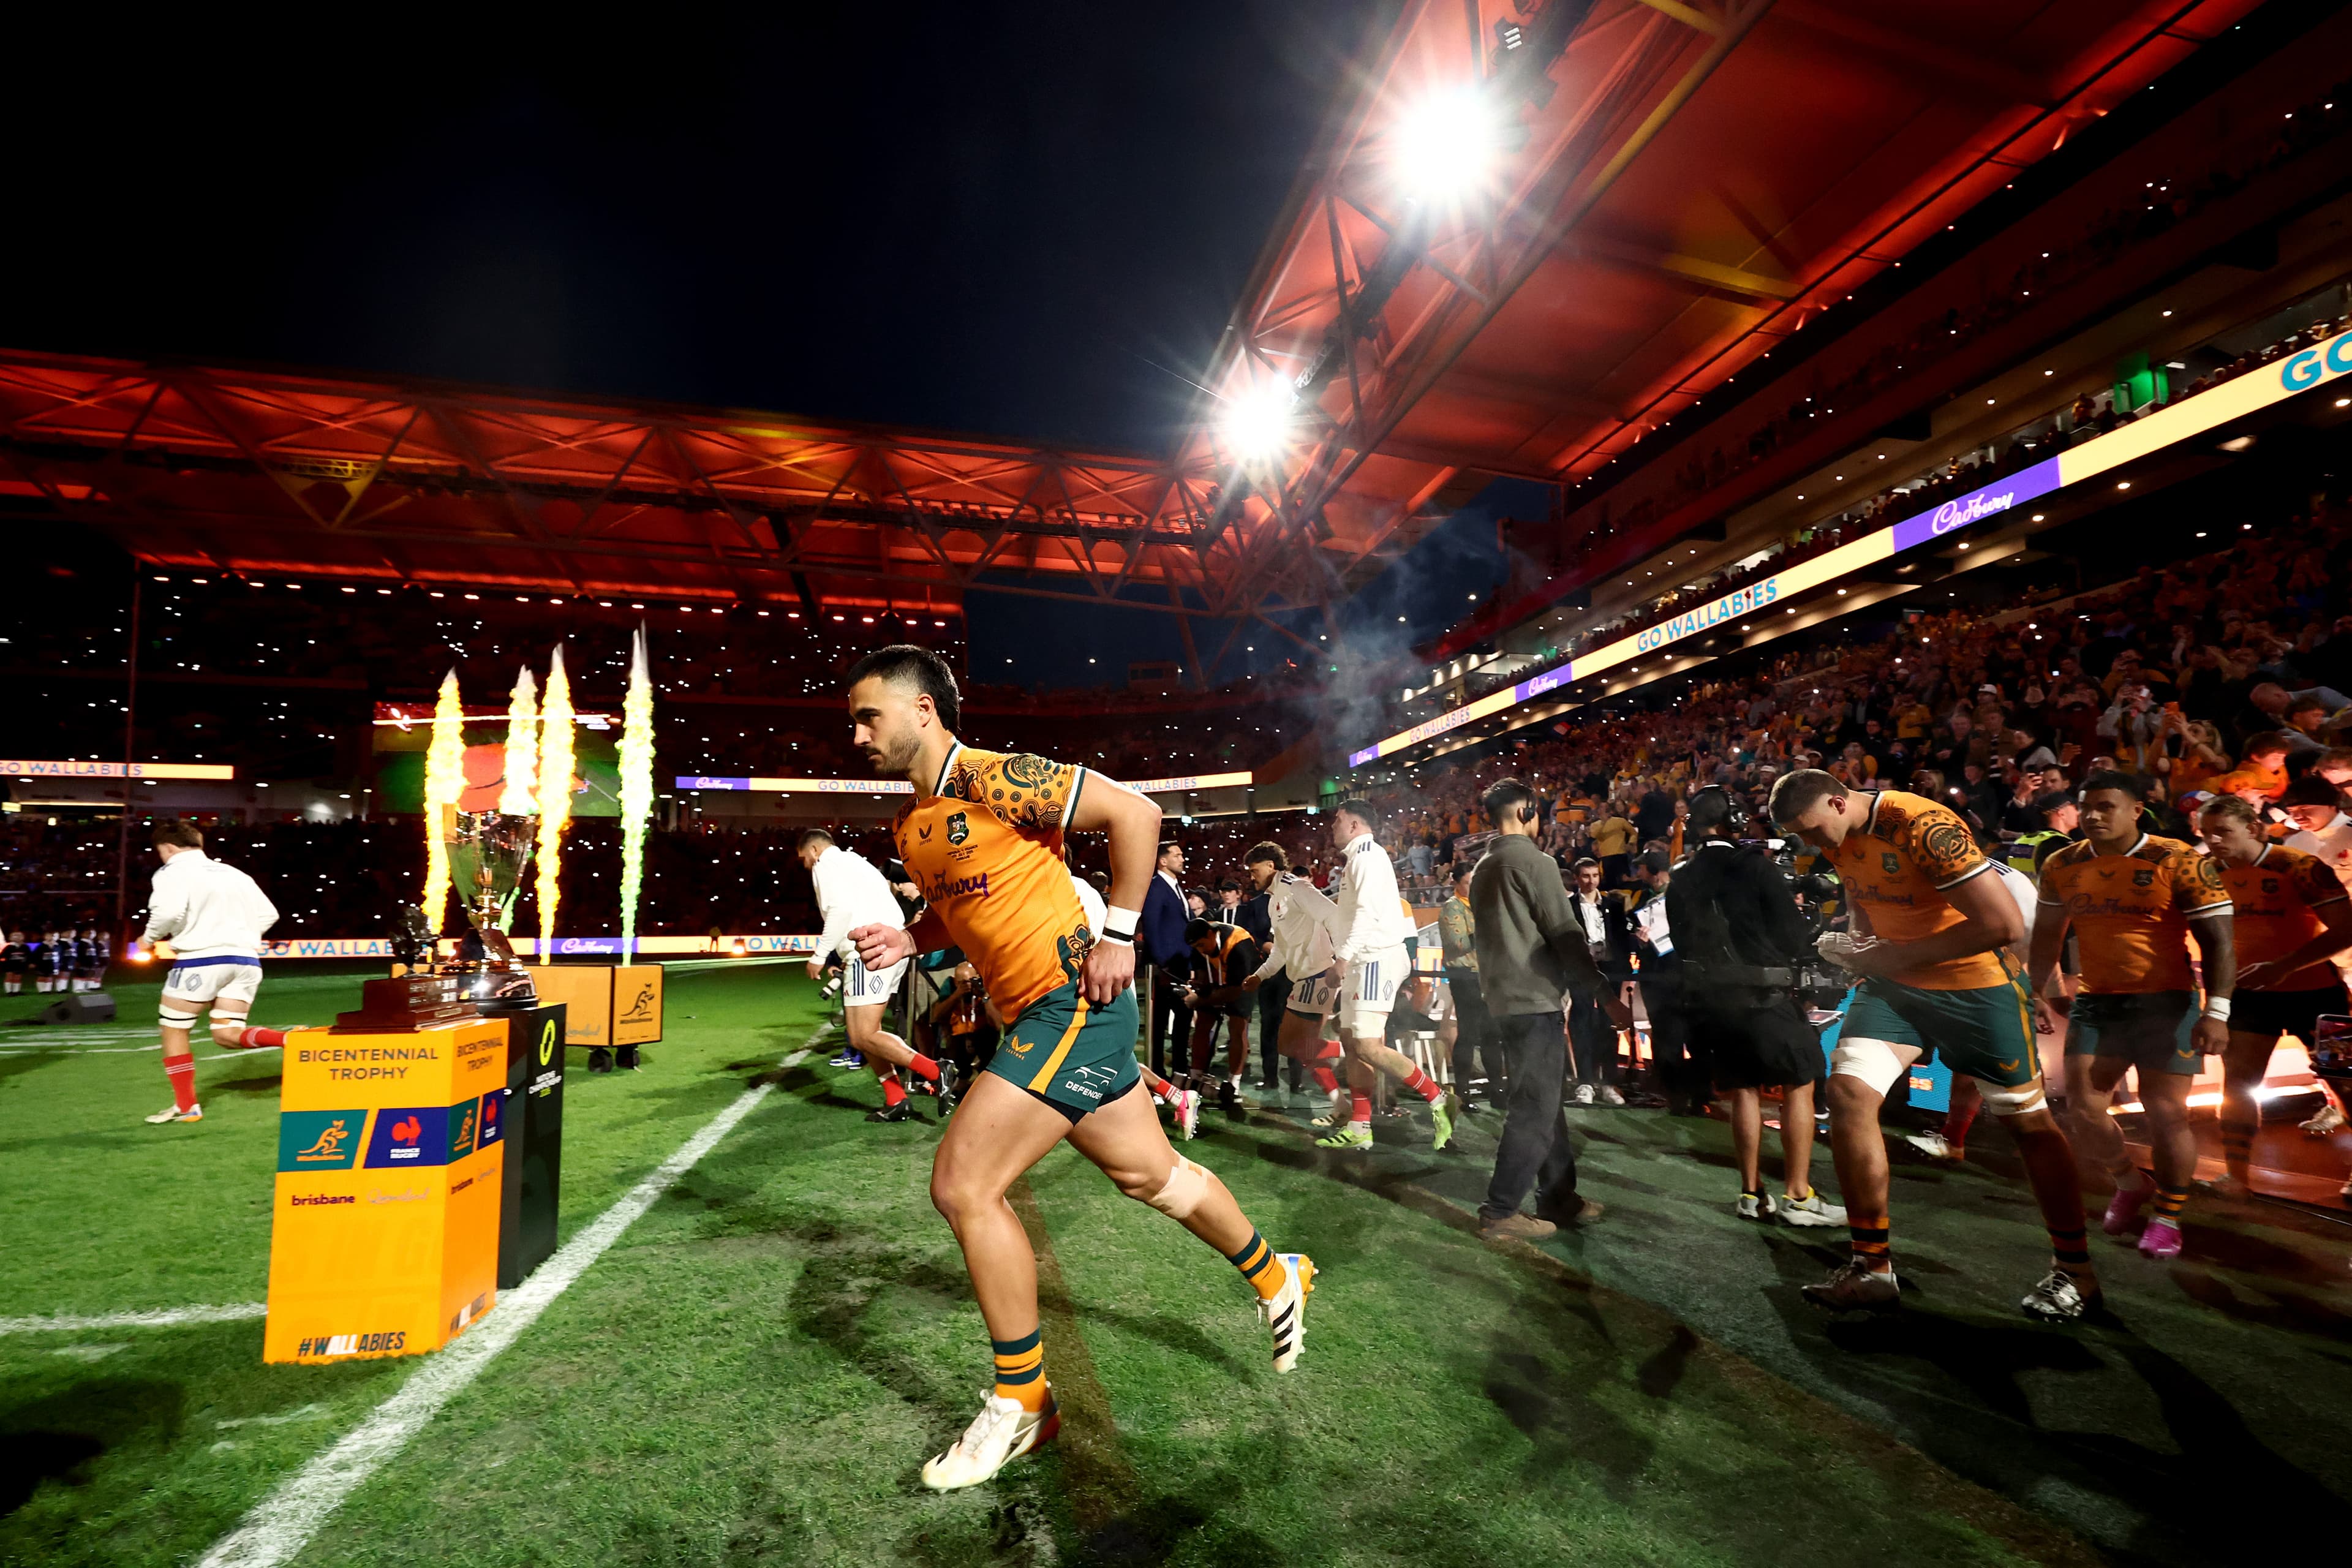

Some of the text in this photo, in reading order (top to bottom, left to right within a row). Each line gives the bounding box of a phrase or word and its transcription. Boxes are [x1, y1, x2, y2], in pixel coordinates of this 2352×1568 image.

[1932, 492, 2014, 535] Cadbury
[1638, 579, 1777, 652] GO WALLABIES
[1410, 707, 1471, 743] GO WALLABIES
[0, 762, 20, 773] O
[818, 781, 914, 792] GO WALLABIE
[1131, 778, 1197, 791] WALLABIES
[299, 1048, 439, 1062] BICENTENNIAL
[330, 1067, 409, 1080] TROPHY
[291, 1194, 355, 1207] brisbane
[298, 1332, 407, 1357] #WALLABIES
